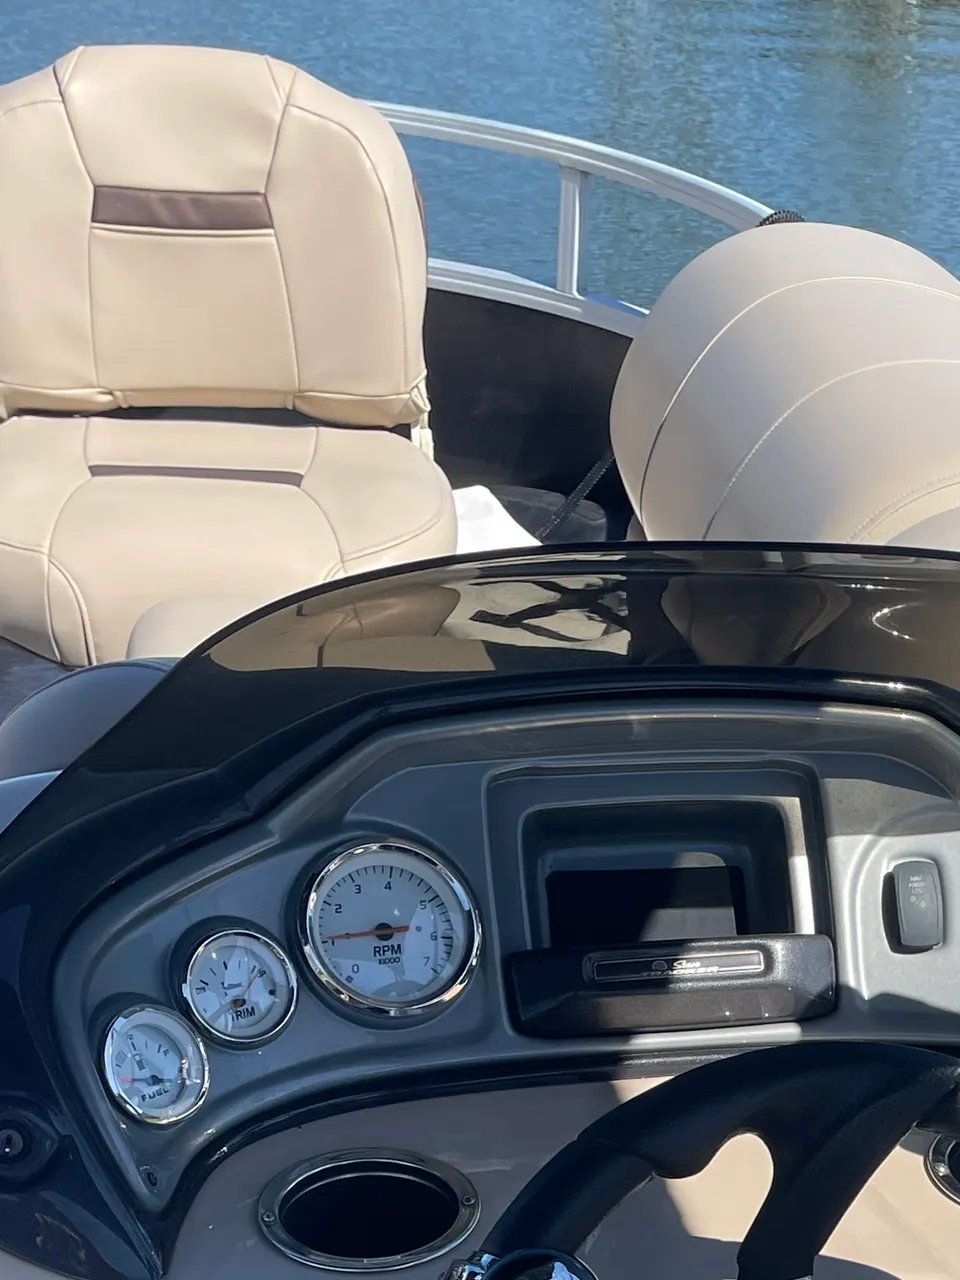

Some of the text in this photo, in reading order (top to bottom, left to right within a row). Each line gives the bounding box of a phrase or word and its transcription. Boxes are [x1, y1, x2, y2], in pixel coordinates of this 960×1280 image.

[354, 884, 362, 894] 3
[384, 881, 392, 891] 4
[334, 903, 343, 914] 2
[419, 900, 428, 910] 5
[430, 932, 438, 941] 6
[373, 943, 402, 957] RPM
[423, 956, 430, 966] 7
[351, 963, 360, 974] 0
[140, 1087, 170, 1103] FUEL
